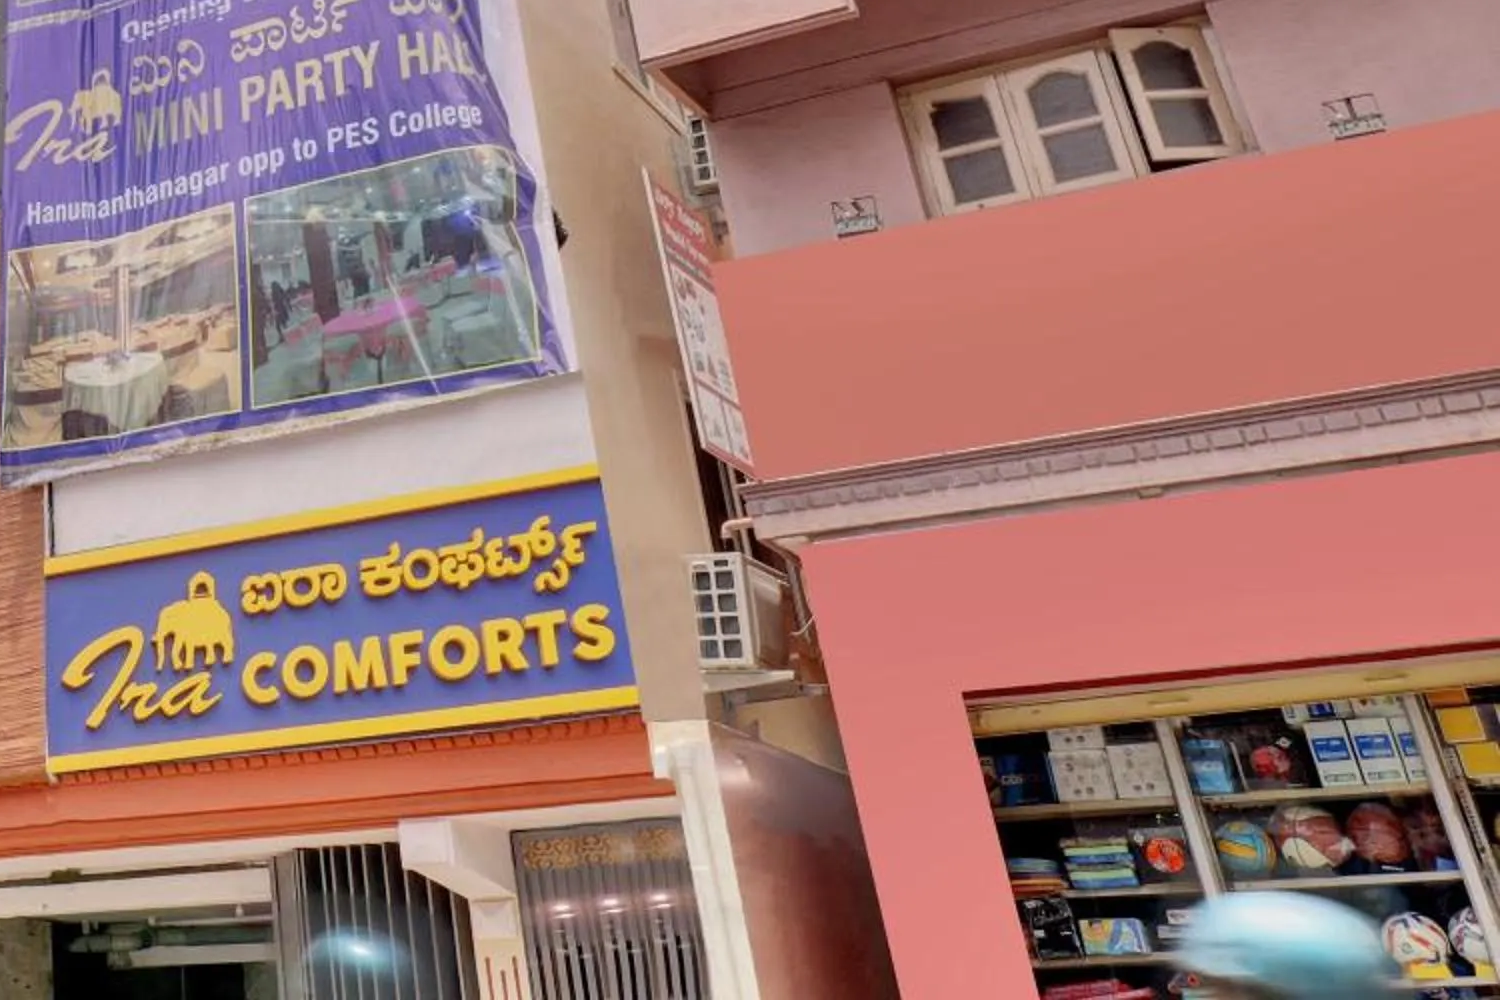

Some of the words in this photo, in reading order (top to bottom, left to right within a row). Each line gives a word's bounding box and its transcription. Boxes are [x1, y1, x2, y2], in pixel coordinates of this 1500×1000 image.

[4, 98, 117, 172] Ira
[134, 87, 224, 158] MINI
[239, 40, 381, 123] PARTY
[27, 161, 229, 226] Hanumanthanagar
[238, 147, 285, 178] opp
[292, 136, 317, 162] to
[327, 117, 379, 154] PES
[389, 102, 483, 138] College
[241, 562, 347, 614] ಐರಾ
[61, 625, 223, 730] Ira
[242, 603, 616, 704] COMFORTS
